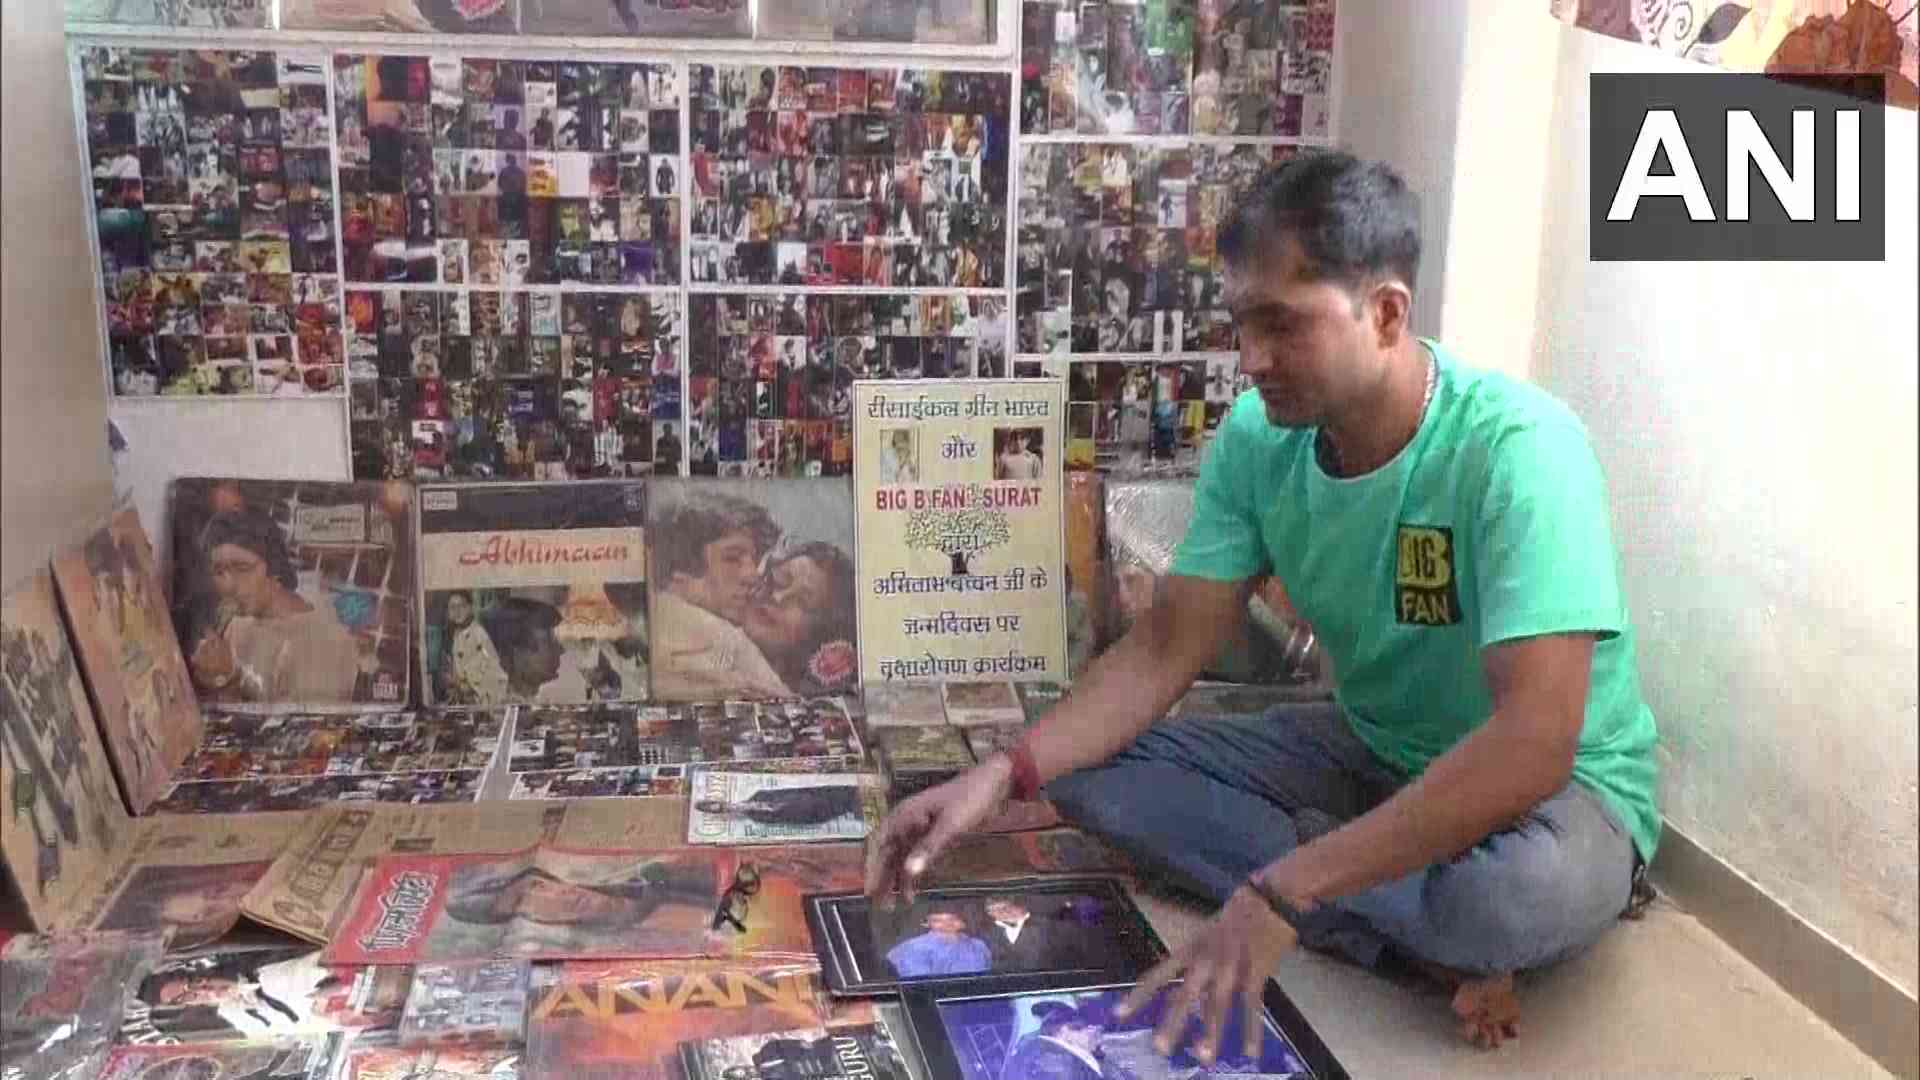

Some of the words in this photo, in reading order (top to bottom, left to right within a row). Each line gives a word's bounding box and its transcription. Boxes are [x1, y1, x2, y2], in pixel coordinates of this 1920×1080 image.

[1005, 398, 1049, 417] भारत
[942, 435, 977, 459] और
[876, 490, 907, 510] BIG
[914, 489, 926, 509] B
[933, 488, 965, 509] FAN
[983, 487, 1042, 508] SURAT
[459, 535, 628, 567] Abhimaan
[873, 571, 945, 595] अमिताभ
[1003, 568, 1025, 591] जी
[1030, 567, 1048, 589] के
[1402, 593, 1449, 624] FAN
[903, 611, 990, 636] जन्मदिवस
[997, 615, 1021, 632] पर
[880, 651, 967, 681] वृक्षारोपण
[974, 650, 1047, 675] कार्यक्रम
